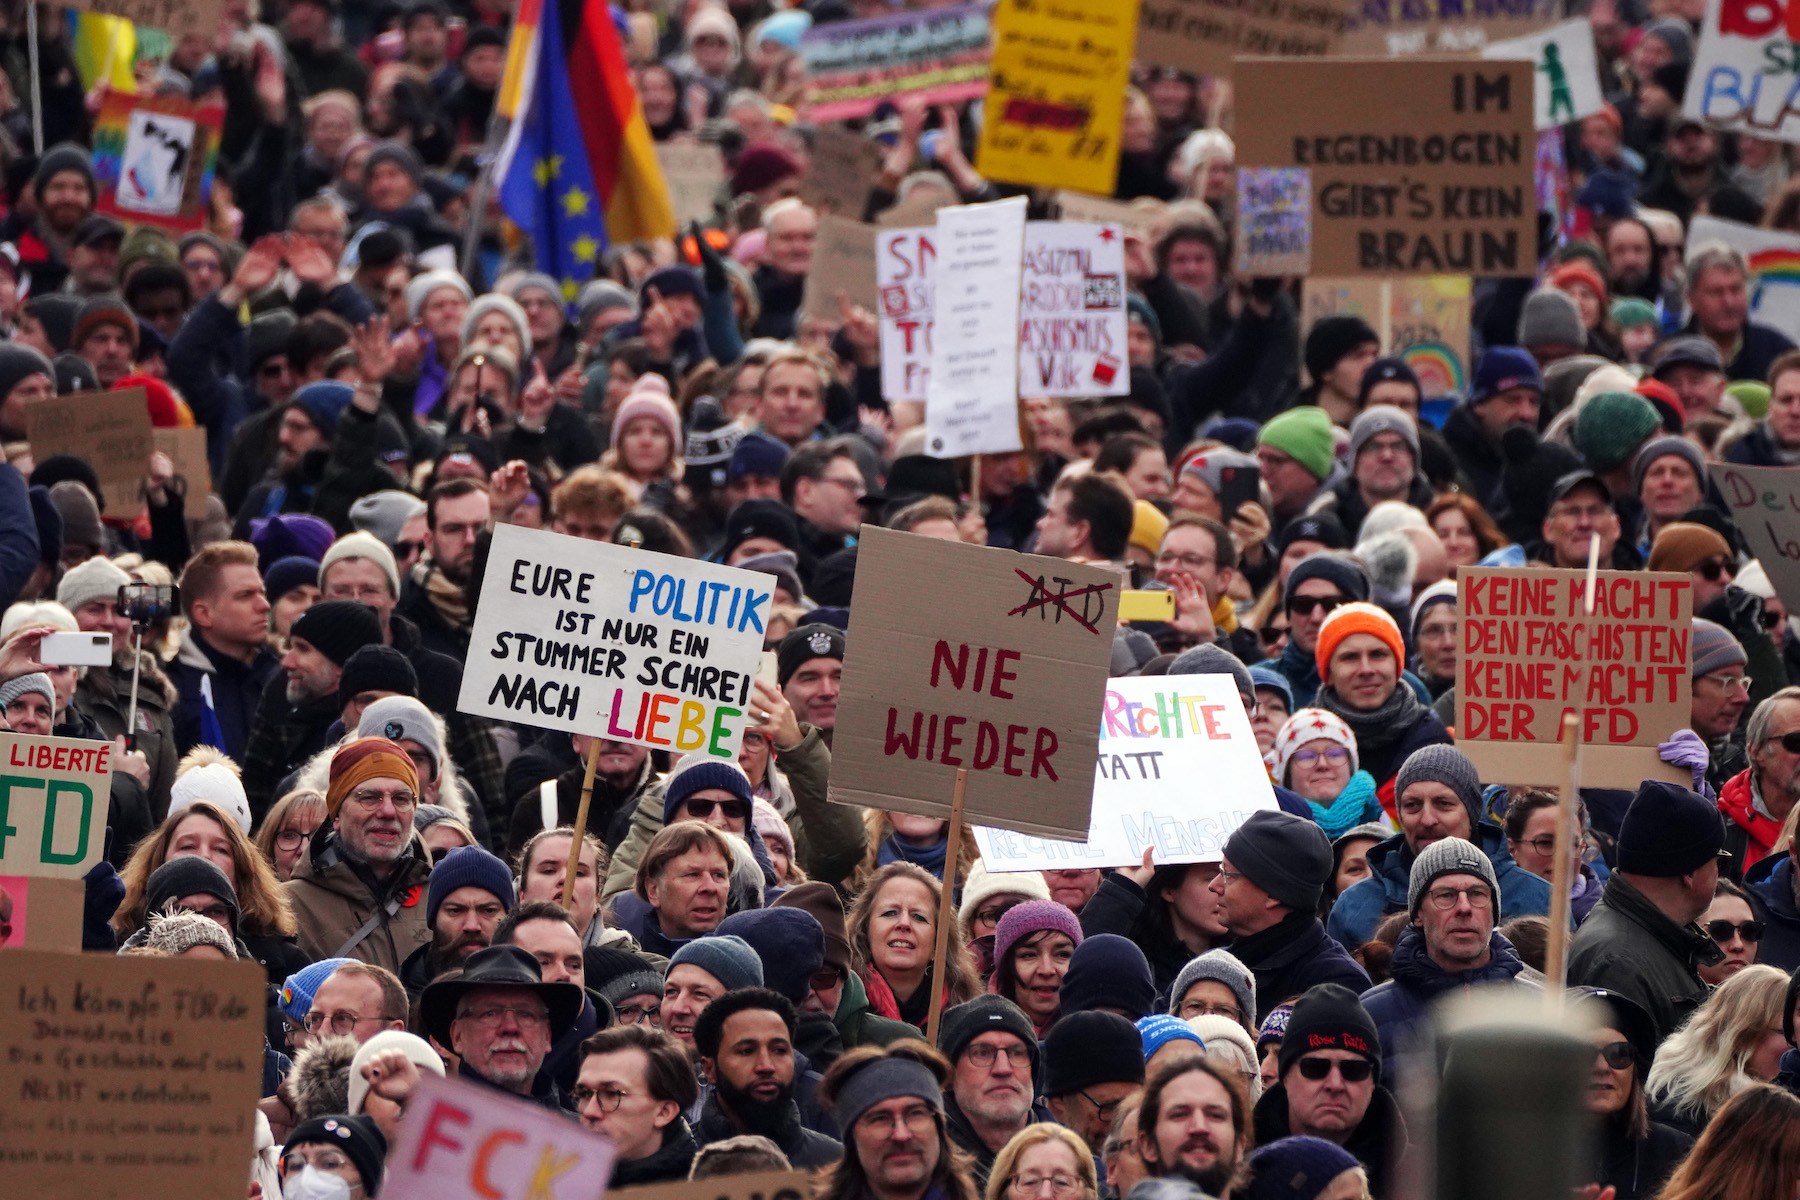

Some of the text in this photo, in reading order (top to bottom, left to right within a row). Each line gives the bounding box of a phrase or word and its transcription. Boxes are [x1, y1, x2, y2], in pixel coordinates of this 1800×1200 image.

[1453, 73, 1511, 113] IM
[1294, 131, 1521, 167] REGENBOGEN
[1319, 176, 1523, 220] GIBT'S KEIN
[1023, 246, 1092, 276] AŠIZMU
[1358, 229, 1518, 271] BRAUN
[1021, 317, 1113, 353] ASCHISMUS
[510, 559, 770, 634] EURE POLITIK
[1465, 576, 1691, 620] KEINE MACHT
[555, 610, 710, 659] IST NUR EIN
[1464, 619, 1689, 665] DEN FASCHISTEN
[490, 631, 750, 706] STUMMER SCHREI
[929, 639, 1021, 700] NIE
[1464, 660, 1687, 706] KEINE MACHT
[487, 673, 743, 758] NACH LIEBE
[1099, 690, 1232, 741] RECHTE
[1464, 702, 1537, 741] DER
[10, 744, 110, 774] LIBERTÉ
[884, 707, 1060, 783] WIEDER
[1097, 751, 1164, 780] TATT
[18, 985, 57, 1013] Ich
[72, 980, 160, 1023] kämpfe
[33, 1019, 174, 1046] Demokratie
[1306, 1033, 1336, 1048] Rose
[20, 1078, 85, 1101] NICHT
[412, 1101, 582, 1200] FCK
